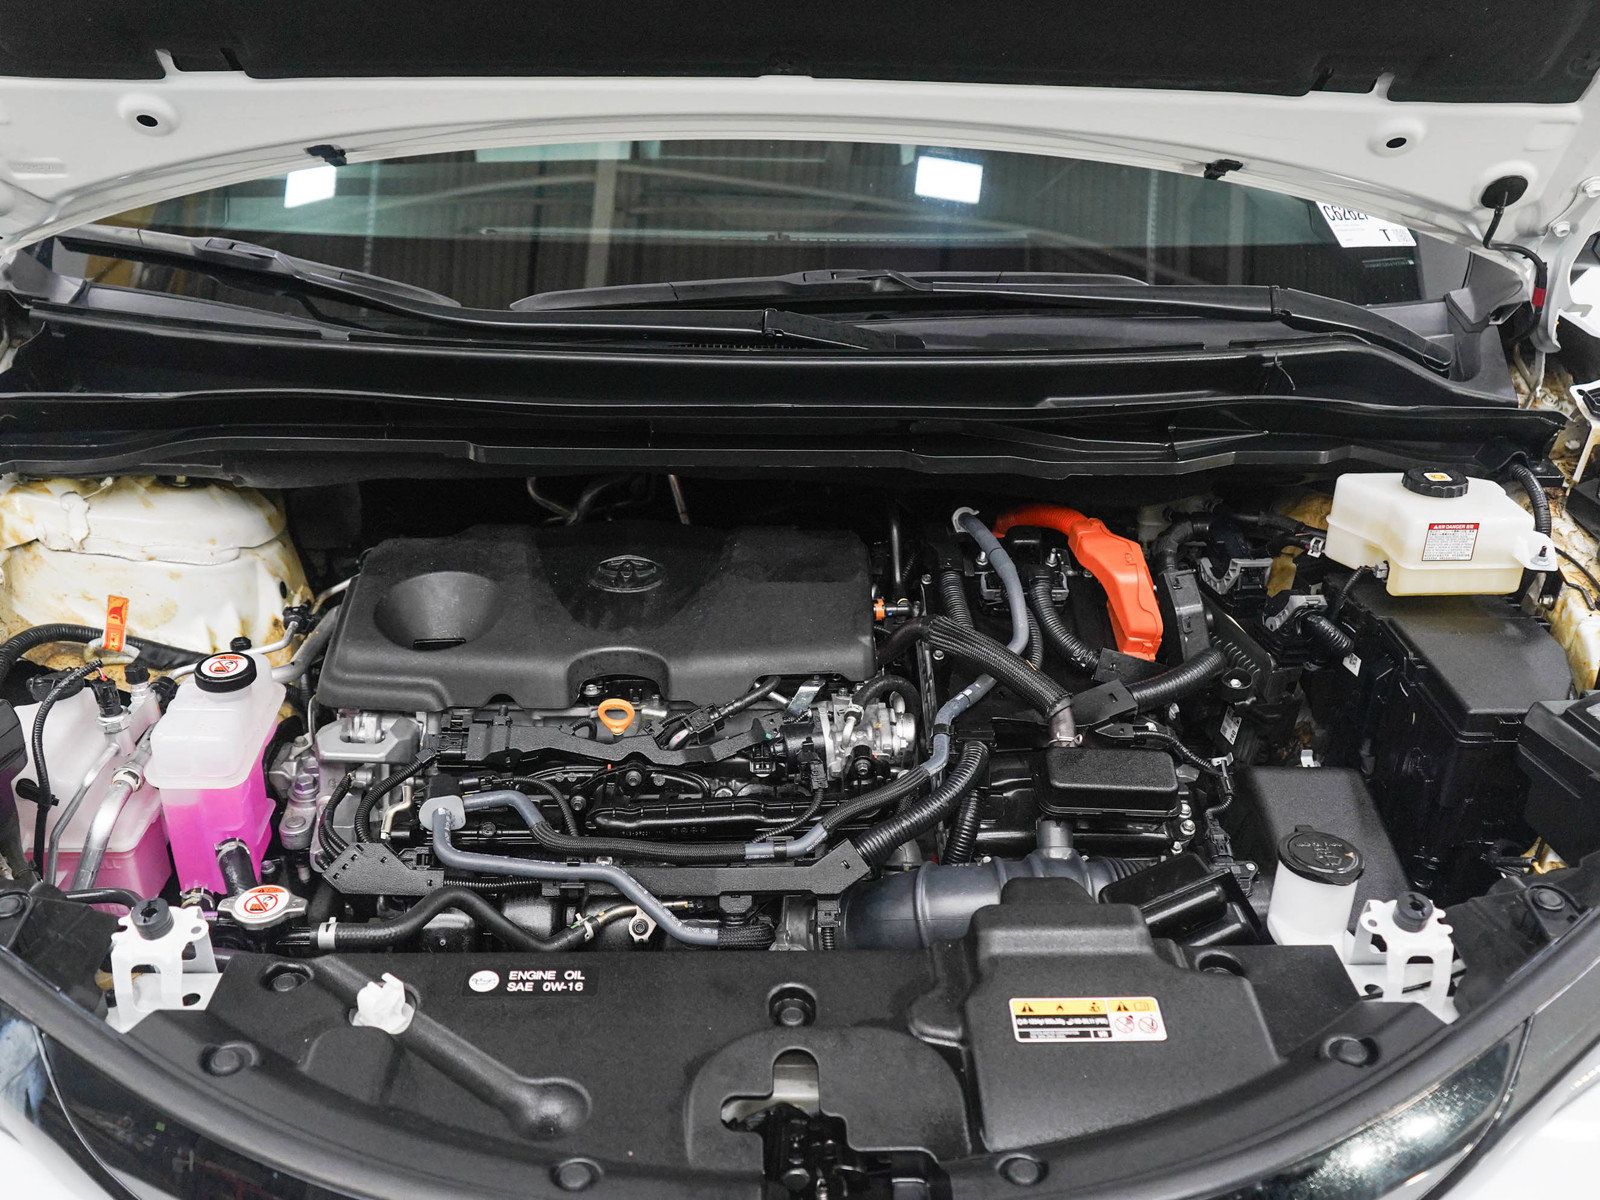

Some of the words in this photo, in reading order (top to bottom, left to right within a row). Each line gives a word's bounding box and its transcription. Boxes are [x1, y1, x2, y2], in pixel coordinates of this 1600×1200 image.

[1379, 229, 1391, 242] T
[508, 970, 557, 981] ENGINE
[564, 970, 586, 981] OIL
[506, 981, 534, 992] SAE
[542, 981, 584, 992] 0W-16
